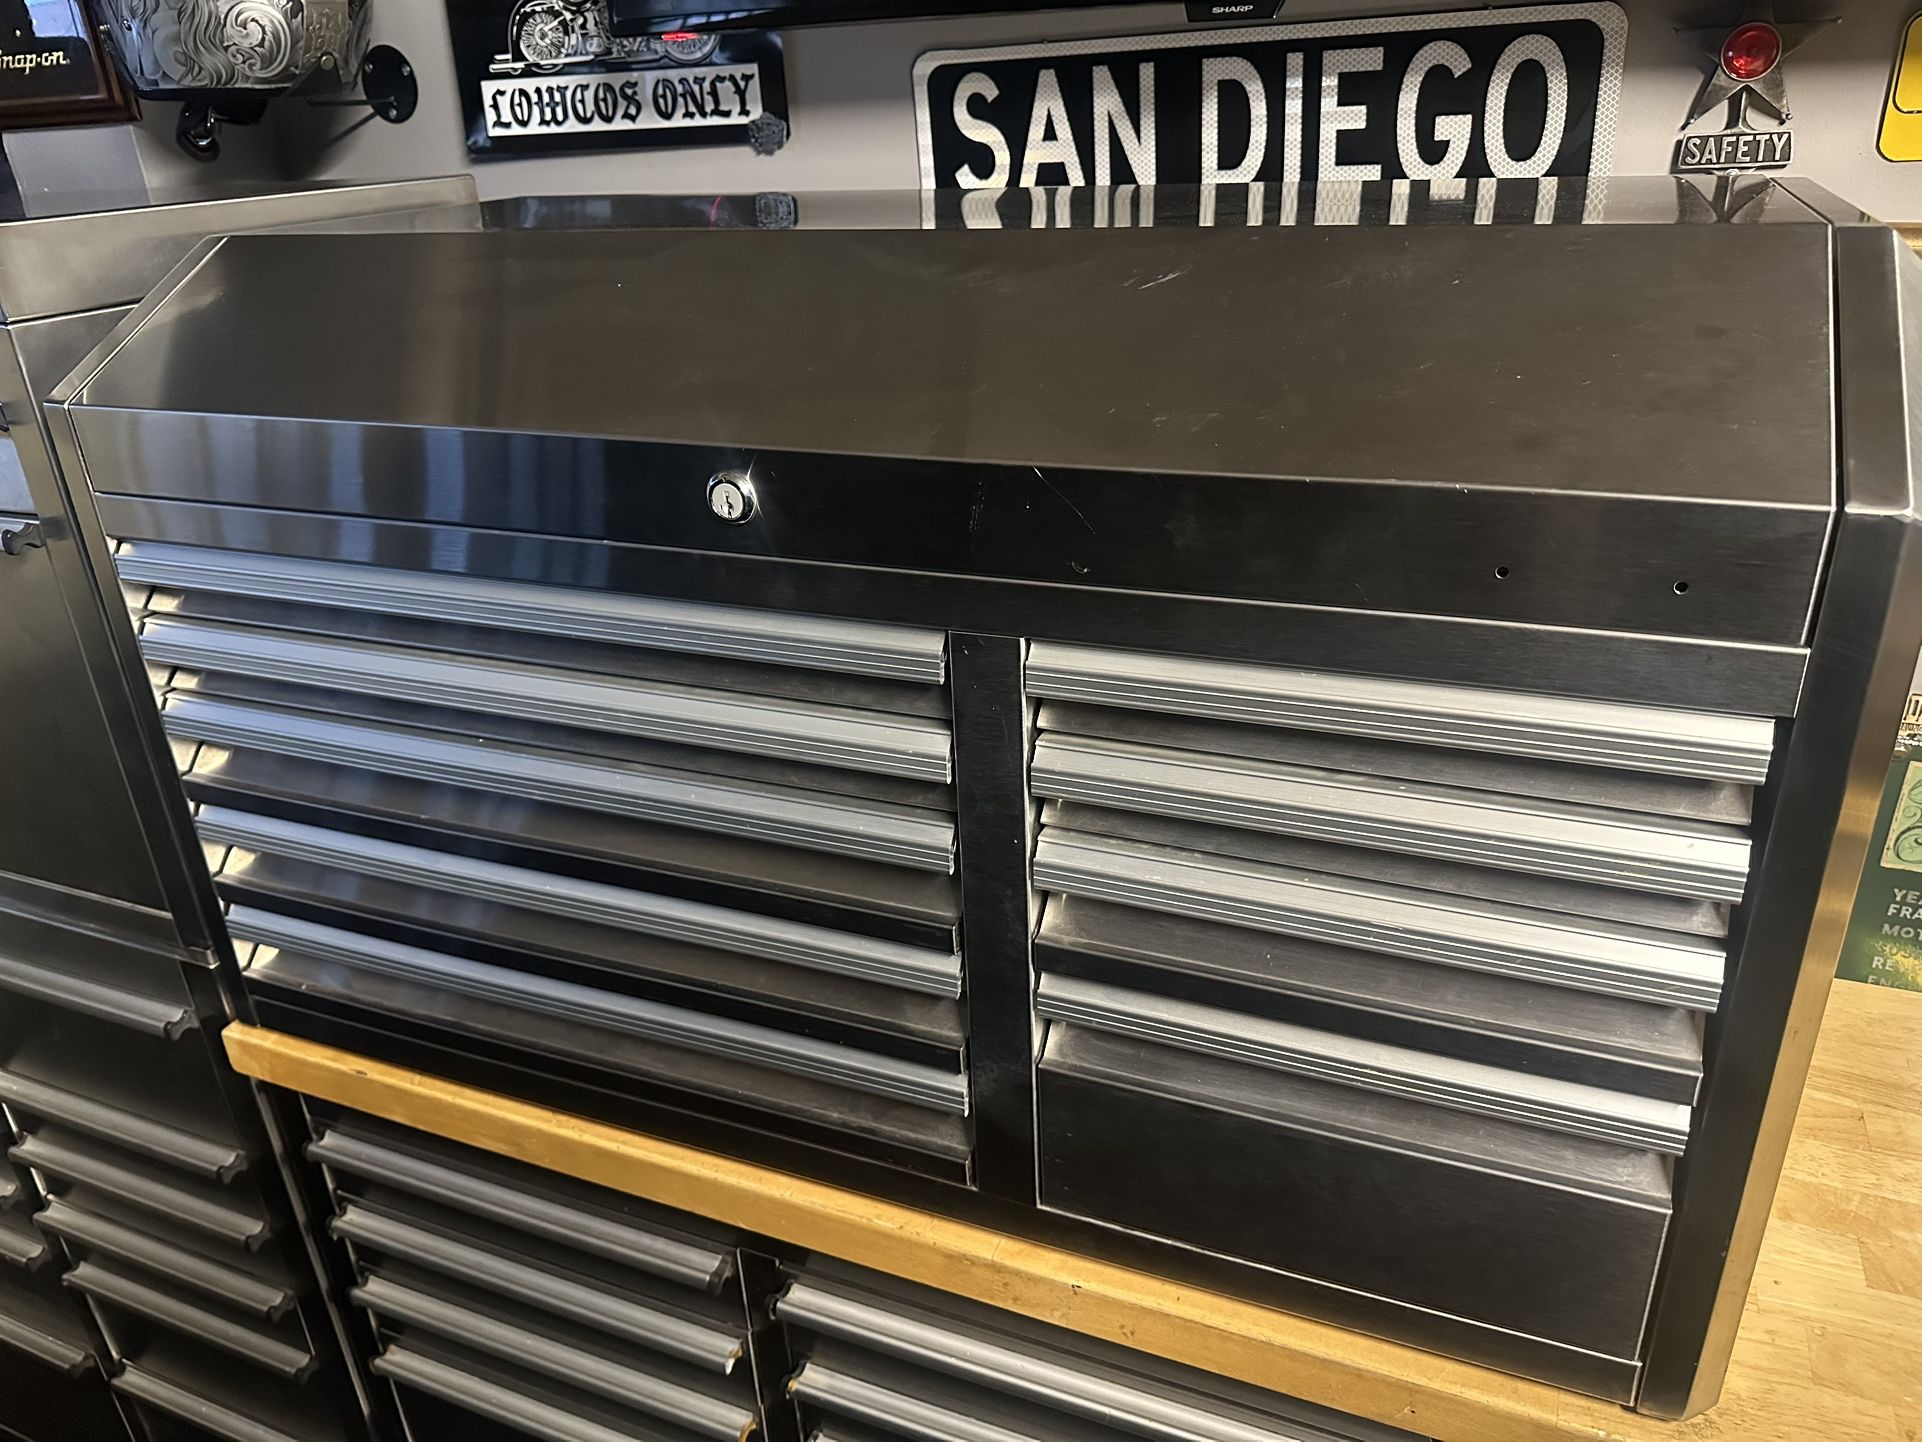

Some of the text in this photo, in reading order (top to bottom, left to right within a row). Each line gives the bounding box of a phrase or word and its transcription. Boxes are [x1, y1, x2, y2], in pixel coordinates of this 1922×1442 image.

[1212, 5, 1253, 14] SHARP
[0, 49, 67, 75] nap-on
[489, 73, 755, 129] LOWCOS ONLY
[952, 33, 1568, 189] SAN DIEGO
[1684, 133, 1789, 164] SAFETY
